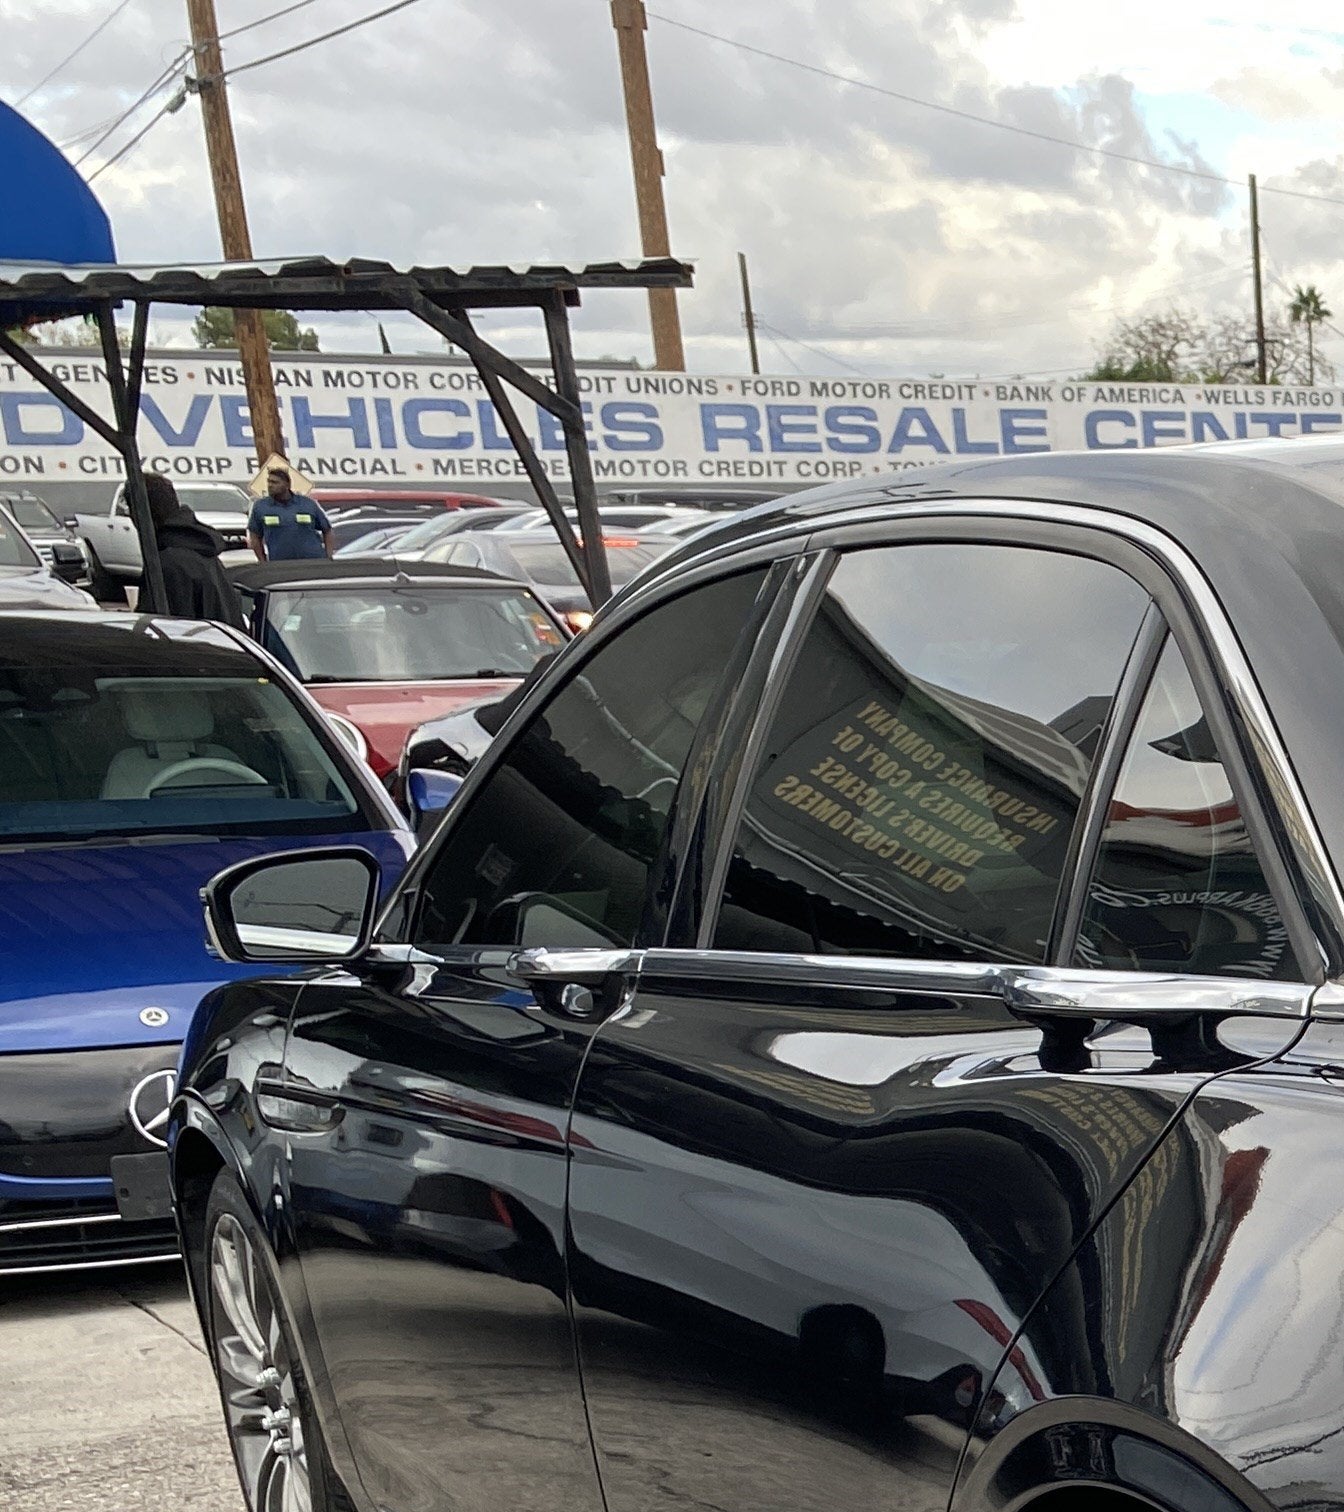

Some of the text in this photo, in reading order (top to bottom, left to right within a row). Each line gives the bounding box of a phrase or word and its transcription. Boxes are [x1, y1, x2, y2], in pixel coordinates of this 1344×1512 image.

[32, 364, 178, 384] GENES
[205, 367, 313, 388] NISAN
[323, 370, 419, 390] MOTOR
[430, 373, 484, 391] COR
[626, 378, 718, 396] UNIONS
[742, 380, 801, 398] FORD
[810, 381, 891, 399] MOTOR
[899, 383, 977, 401] CREDIT
[995, 385, 1053, 402] BANK
[1061, 386, 1087, 402] OF
[1096, 387, 1185, 405] AMERICA
[1203, 389, 1266, 406] WELLS
[1271, 391, 1334, 407] FARGO
[700, 402, 1051, 455] RESALE
[78, 455, 233, 475] CITCORP
[246, 457, 406, 476] FANCIAL
[432, 458, 566, 476] MERCEE
[594, 459, 689, 477] MOTOR
[699, 460, 788, 478] CREDIT
